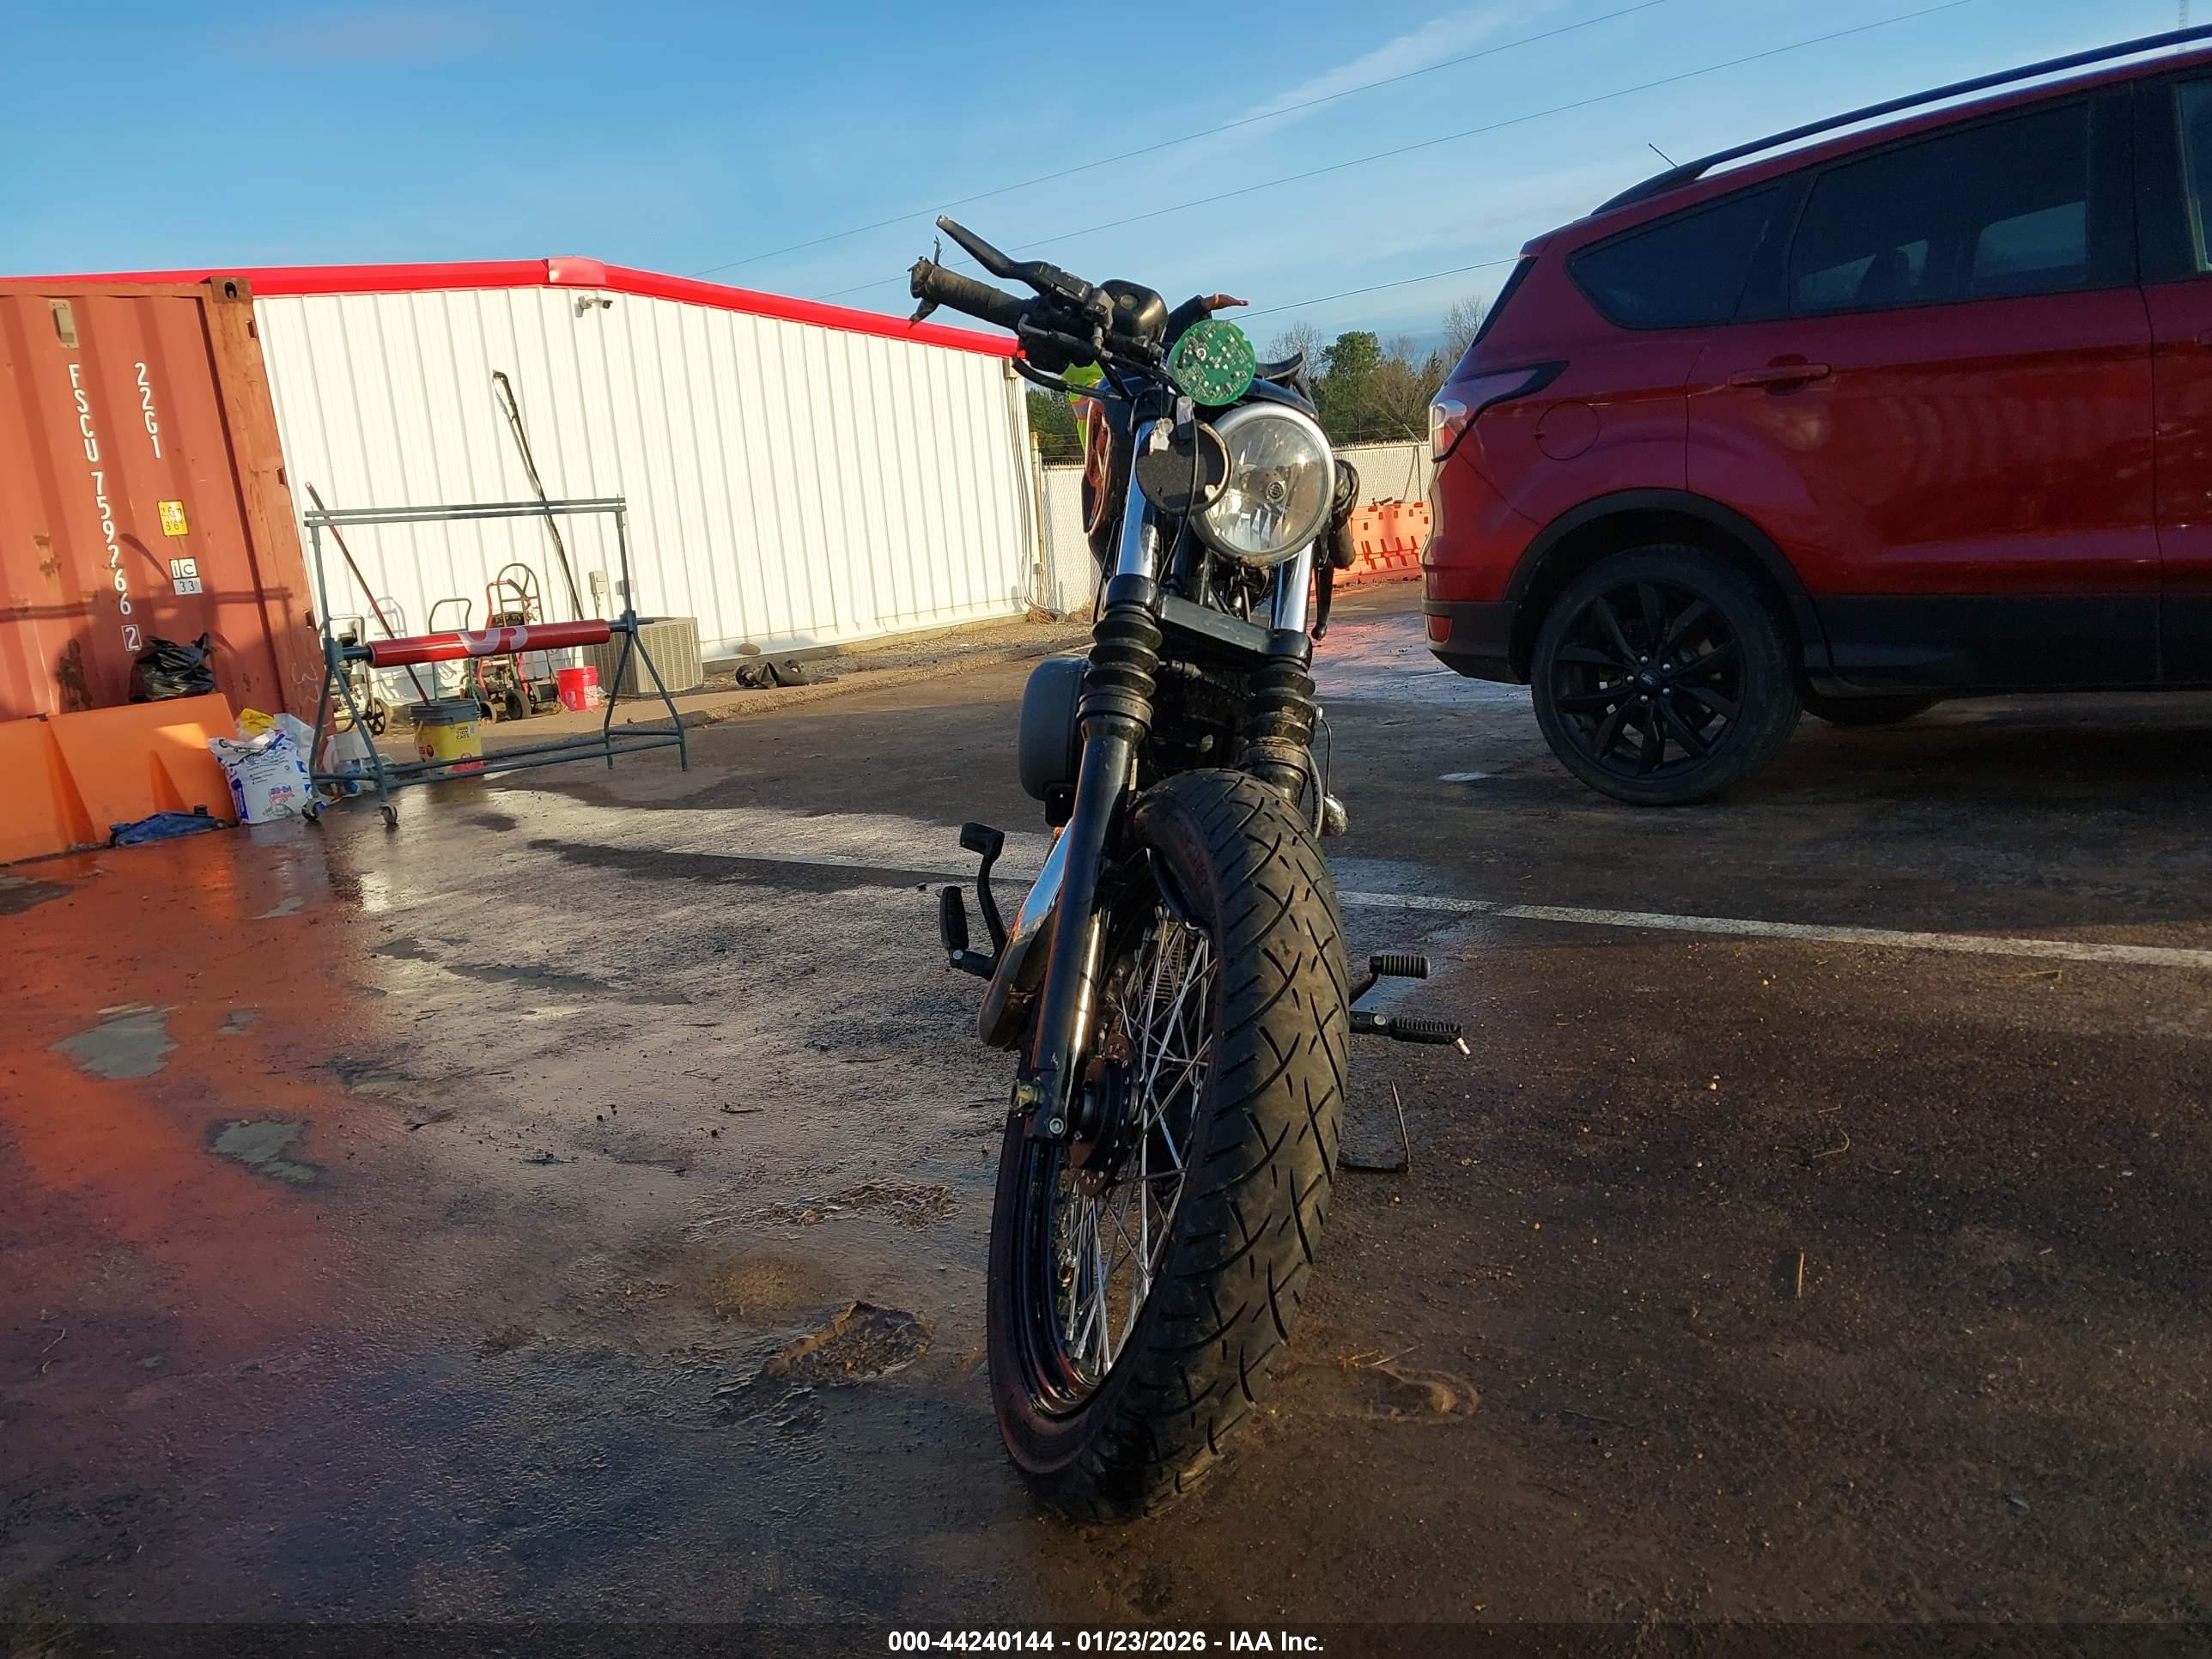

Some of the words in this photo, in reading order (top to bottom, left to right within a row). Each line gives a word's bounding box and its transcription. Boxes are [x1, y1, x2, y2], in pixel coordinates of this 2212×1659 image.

[135, 362, 161, 459] 22G1
[69, 363, 99, 462] FSCU
[125, 626, 140, 650] 2
[179, 580, 195, 592] 33
